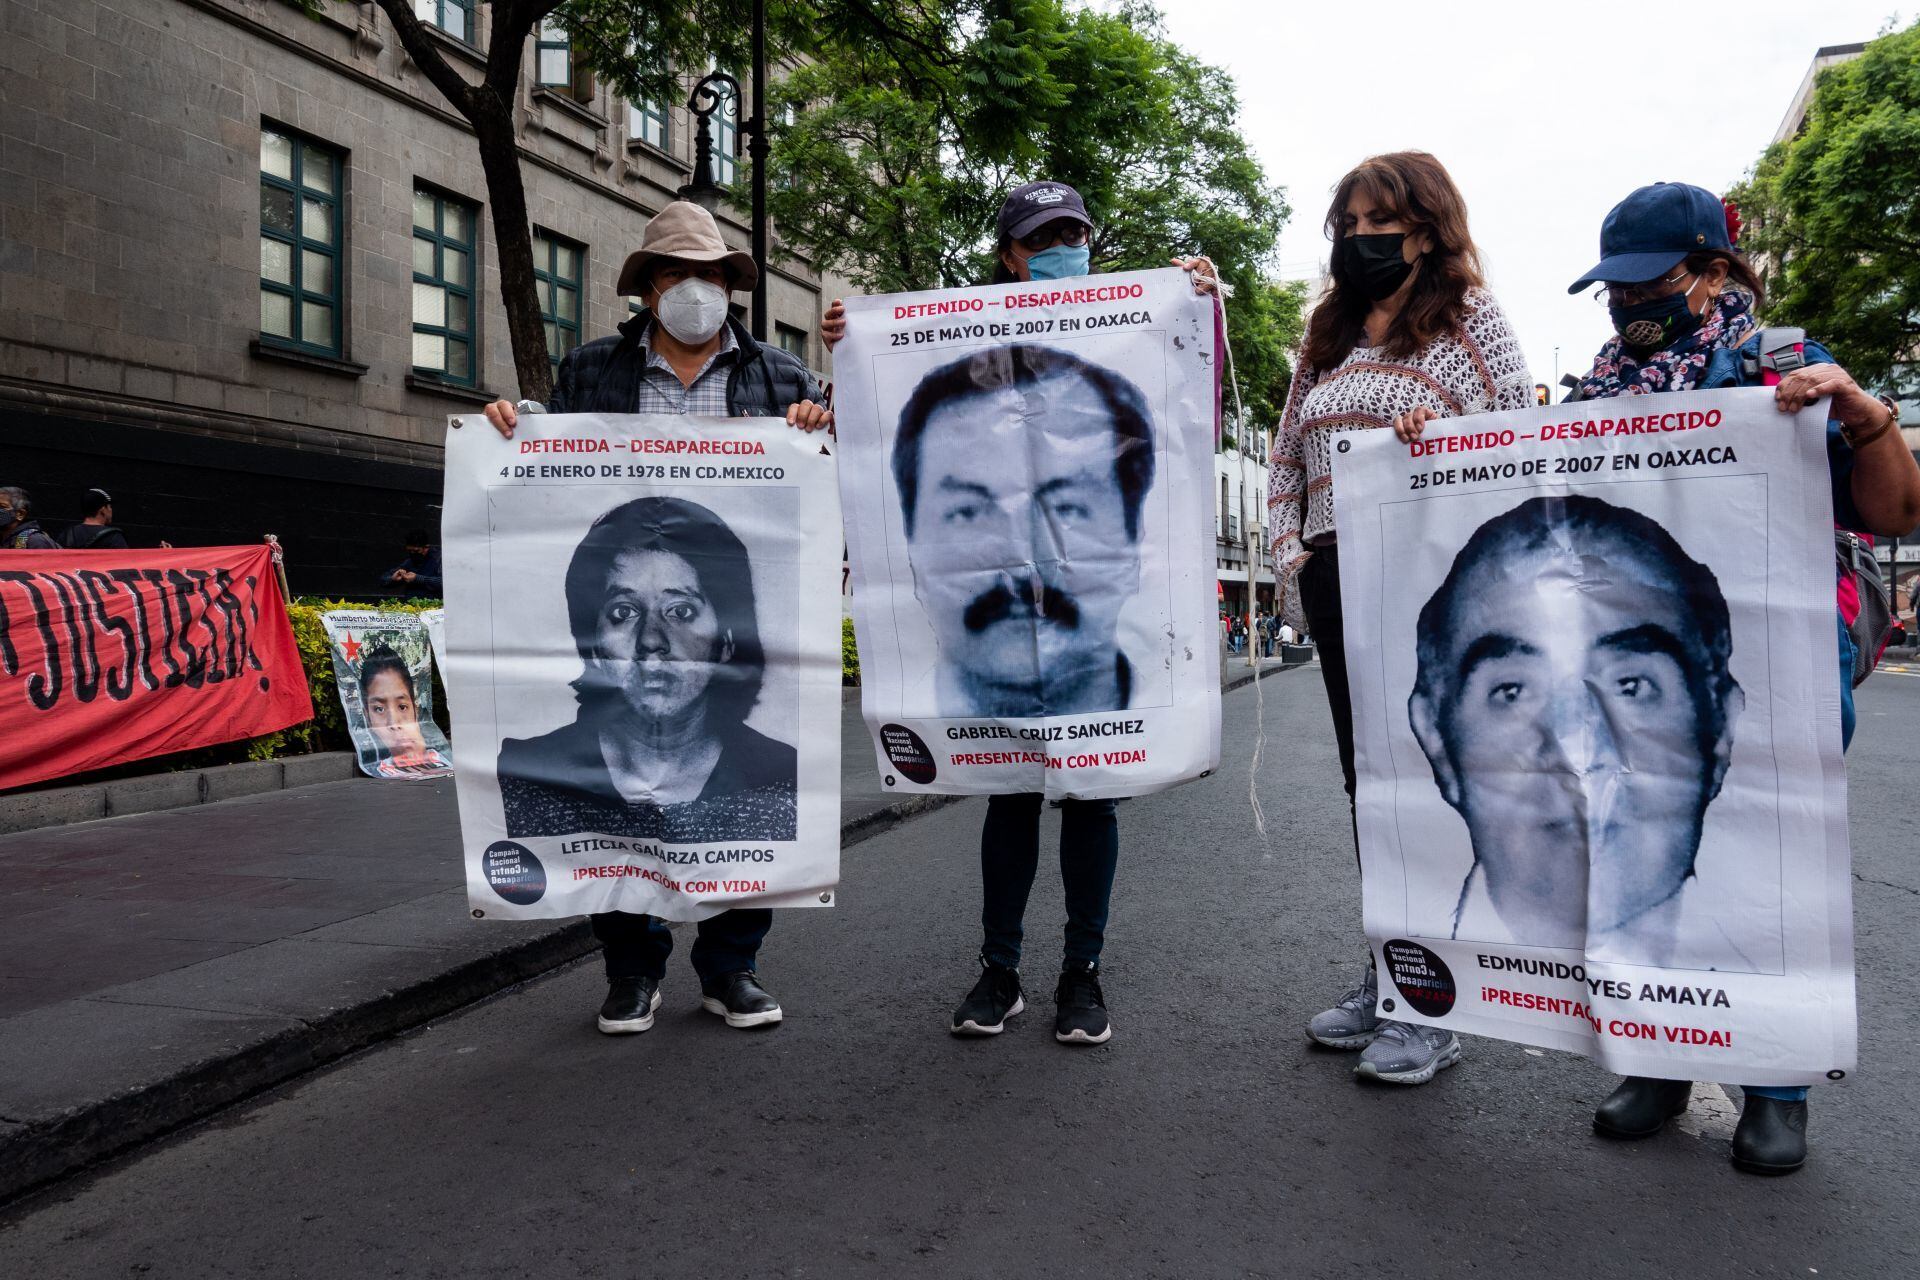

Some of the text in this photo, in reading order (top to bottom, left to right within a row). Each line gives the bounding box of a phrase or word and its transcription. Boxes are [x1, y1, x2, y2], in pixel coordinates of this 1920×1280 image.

[1025, 188, 1048, 200] SINCE
[895, 299, 983, 319] DETENIDO
[1005, 284, 1143, 309] DESAPARECIDO
[891, 312, 1151, 346] 25 DE MAYO DE 2007 EN OAXACA
[1410, 429, 1514, 458] DETENIDO
[1541, 410, 1721, 441] DESAPARECIDO
[520, 439, 608, 454] DETENIDA
[631, 439, 764, 455] DESAPARECIDA
[500, 465, 784, 479] 4 DE ENERO DE 1978 EN CD.MEXICO
[1411, 447, 1737, 489] 25 DE MAYO DE 2007 EN OAXACA
[947, 720, 1143, 741] GABRIEL CRUZ SANCHEZ
[1066, 755, 1099, 768] CON
[1104, 751, 1146, 765] VIDA!
[490, 849, 519, 858] Campaña
[562, 839, 774, 864] LETICIA GALARZA CAMPOS
[490, 856, 520, 866] Nacional
[686, 881, 718, 893] CON
[722, 880, 766, 892] VIDA!
[1389, 946, 1423, 955] Campaña
[1392, 953, 1425, 963] Nacional
[1477, 954, 1730, 1008] EDMUNDO YES AMAYA
[1609, 1020, 1656, 1040] CON
[1664, 1027, 1731, 1047] VIDA!
